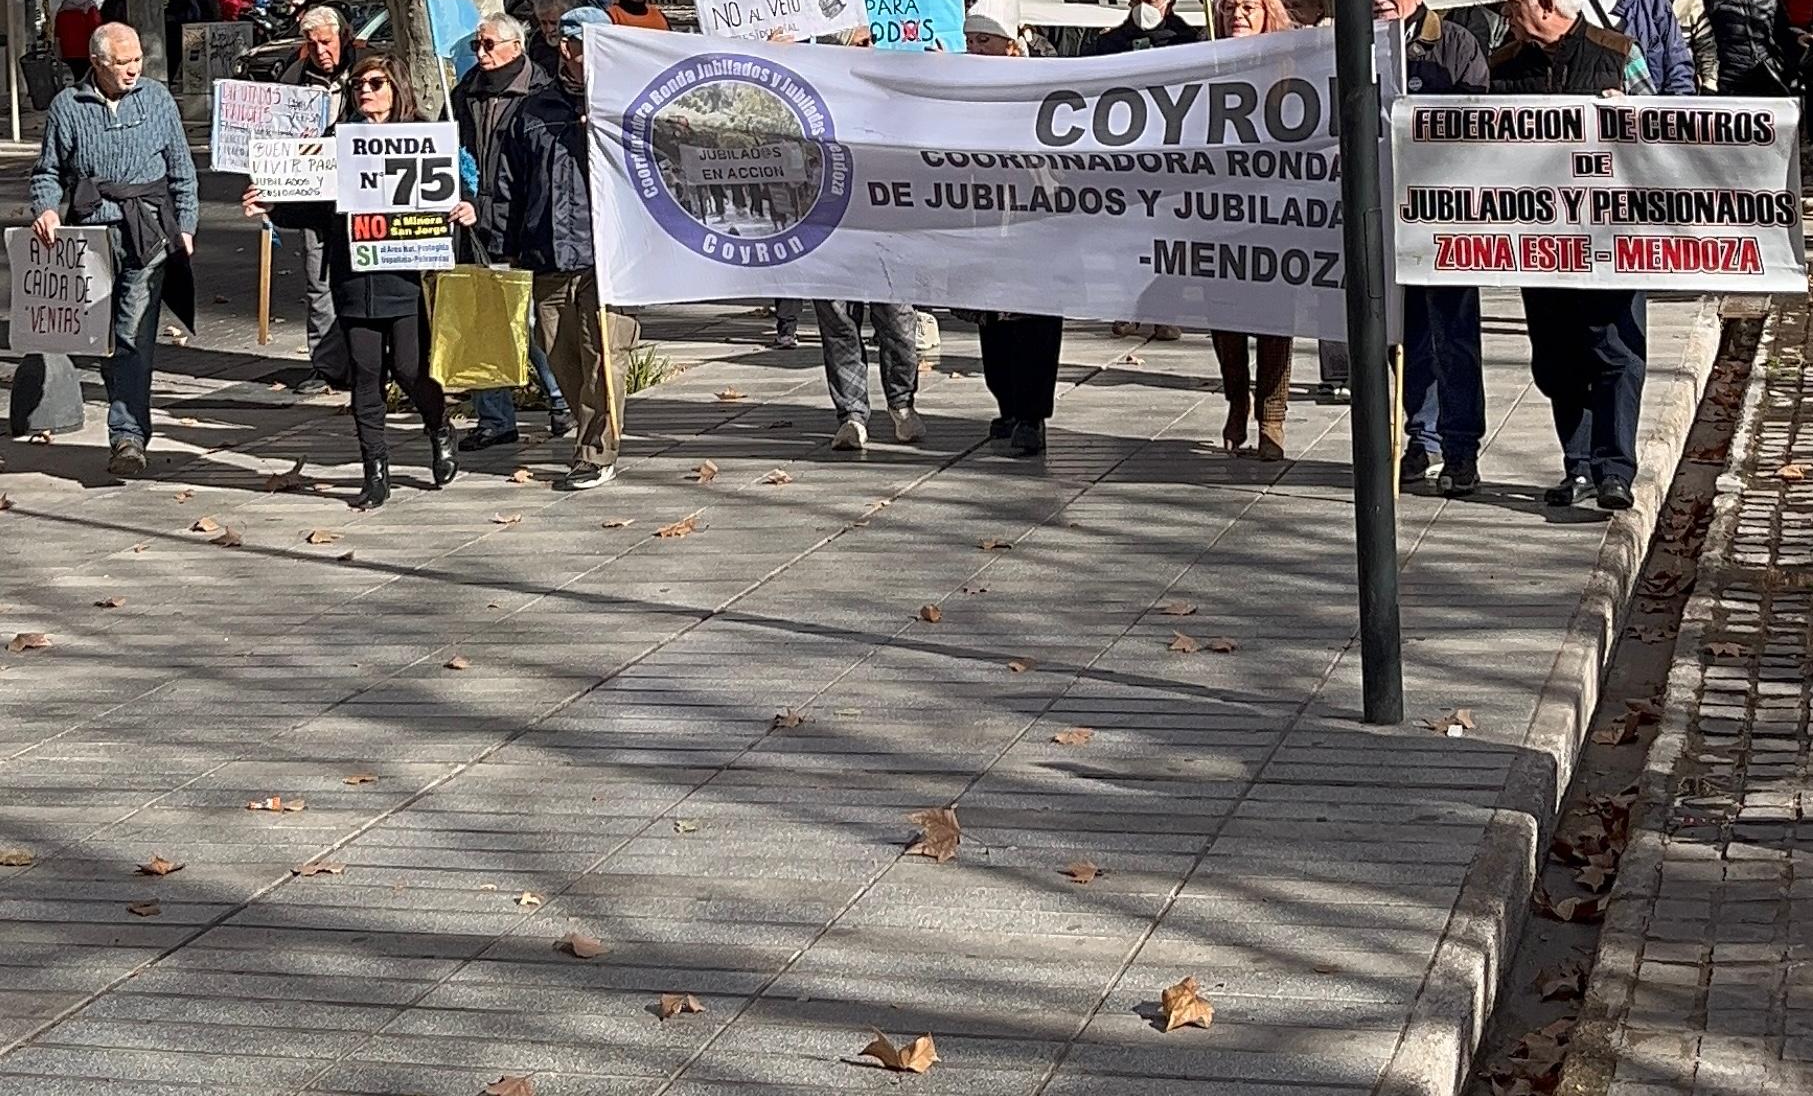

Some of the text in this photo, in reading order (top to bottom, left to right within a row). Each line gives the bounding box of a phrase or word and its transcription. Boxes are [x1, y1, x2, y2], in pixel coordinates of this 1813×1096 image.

[711, 1, 743, 31] NO
[749, 8, 765, 24] AL
[870, 19, 935, 44] ODOS
[650, 69, 697, 105] Ronda
[697, 59, 769, 83] Jubilados
[770, 74, 783, 88] y
[779, 76, 827, 137] Jubiladas
[827, 141, 849, 196] endoza
[1412, 105, 1776, 146] FEDERACION DE CENTROS
[351, 137, 437, 156] RONDA
[702, 165, 785, 181] EN ACCION
[1572, 151, 1614, 178] DE
[316, 176, 324, 188] Y
[385, 157, 456, 206] 75
[867, 181, 915, 208] DE
[925, 182, 1127, 217] JUBILADOS
[1137, 188, 1163, 218] Y
[1400, 186, 1798, 228] JUBILADOS Y PENSIONADOS
[353, 215, 388, 241] NO
[356, 245, 380, 267] SI
[1138, 239, 1347, 290] -MENDOZ
[1434, 233, 1518, 272] ZONA
[1519, 234, 1593, 273] ESTE
[1613, 234, 1765, 275] MENDOZA
[23, 266, 94, 304] CAÍDA DE
